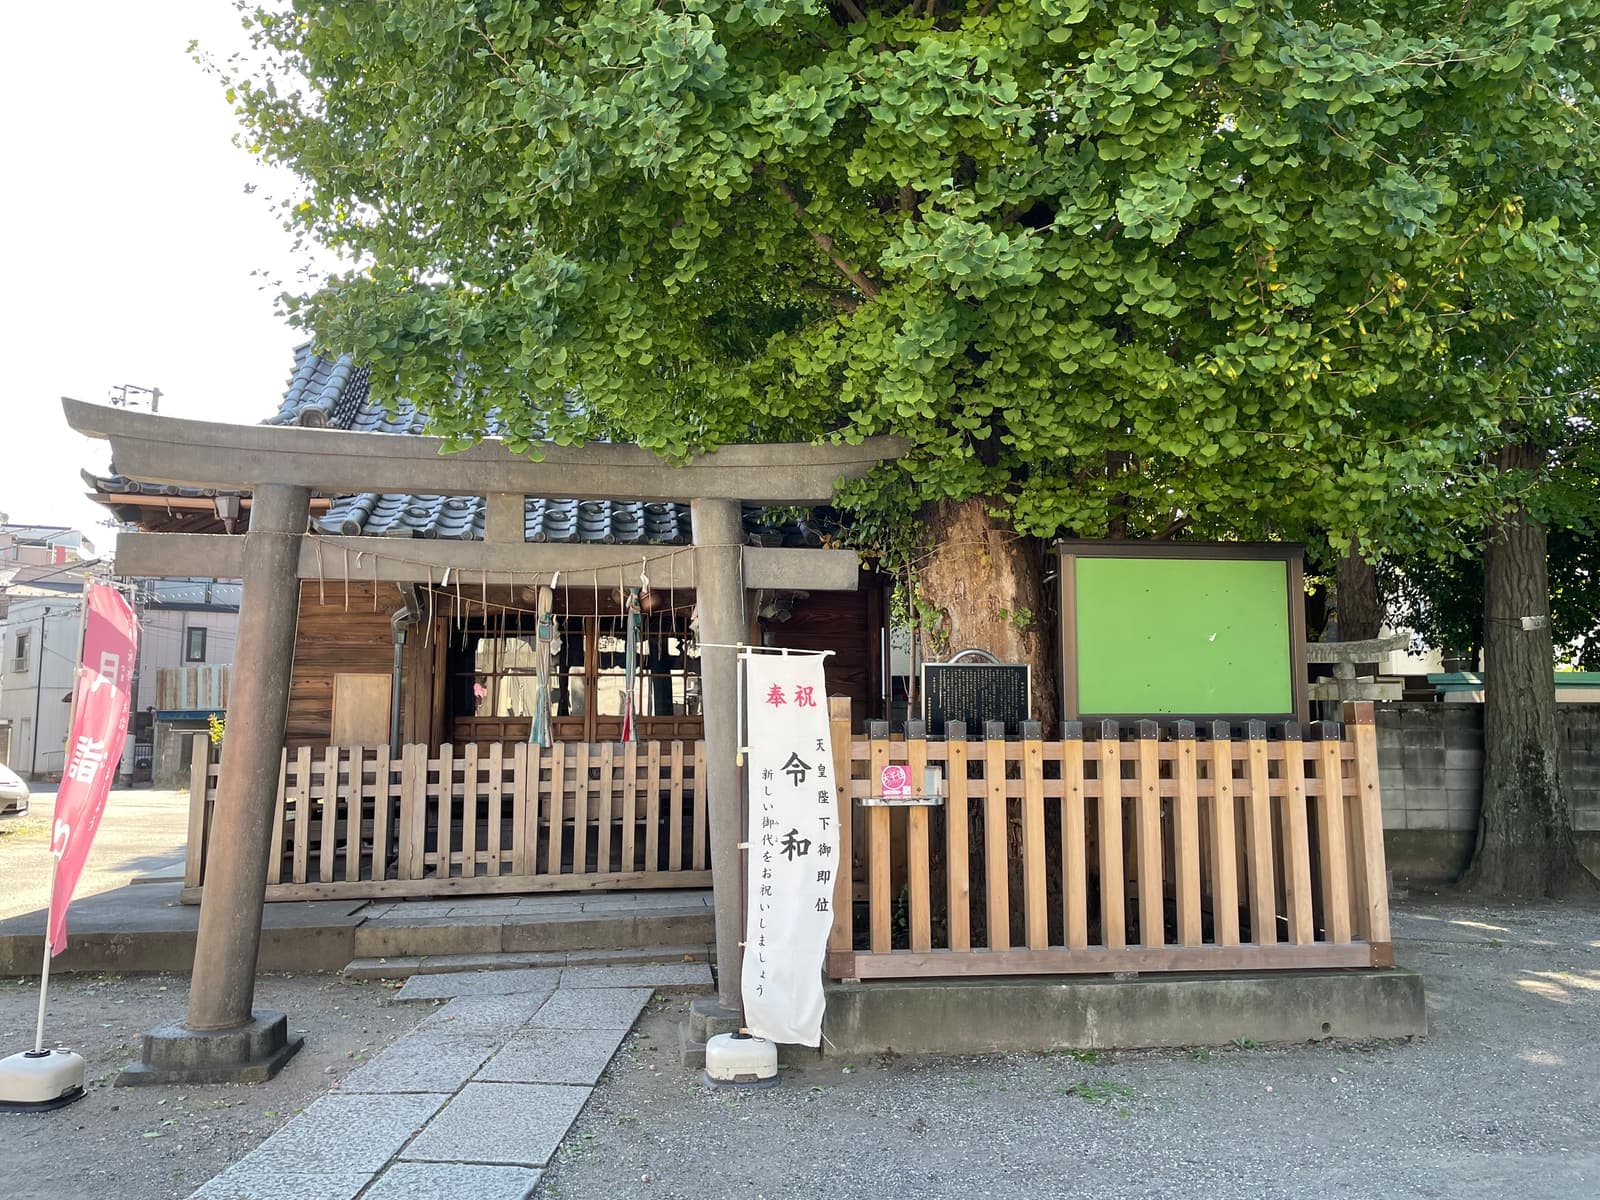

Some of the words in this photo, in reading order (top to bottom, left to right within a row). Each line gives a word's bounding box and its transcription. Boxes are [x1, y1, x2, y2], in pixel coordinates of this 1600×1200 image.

[766, 683, 817, 708] 奉祝
[779, 752, 813, 862] 令和
[815, 738, 832, 912] 天皇陛下御即位
[756, 769, 774, 998] 新しい御代をお祝いしましょう
